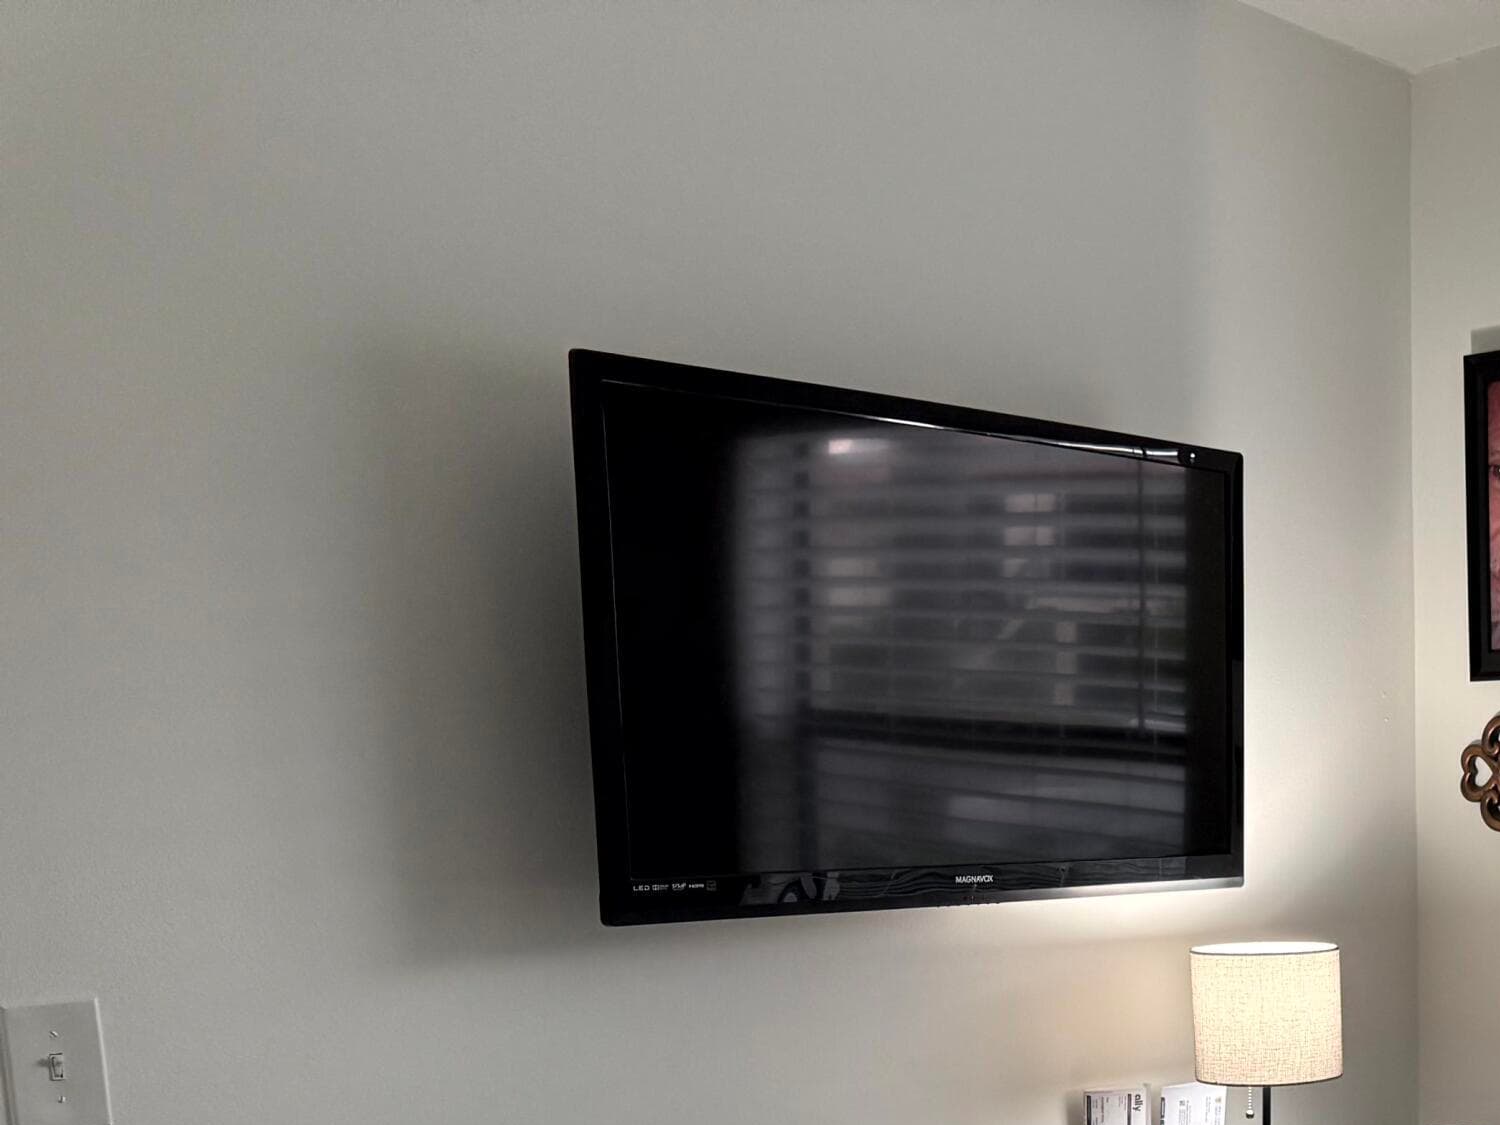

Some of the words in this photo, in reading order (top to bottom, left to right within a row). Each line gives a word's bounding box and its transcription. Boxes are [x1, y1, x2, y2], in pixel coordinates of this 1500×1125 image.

[955, 874, 994, 884] MAGNAVOX
[632, 884, 650, 892] LED
[1132, 1093, 1143, 1111] ally
